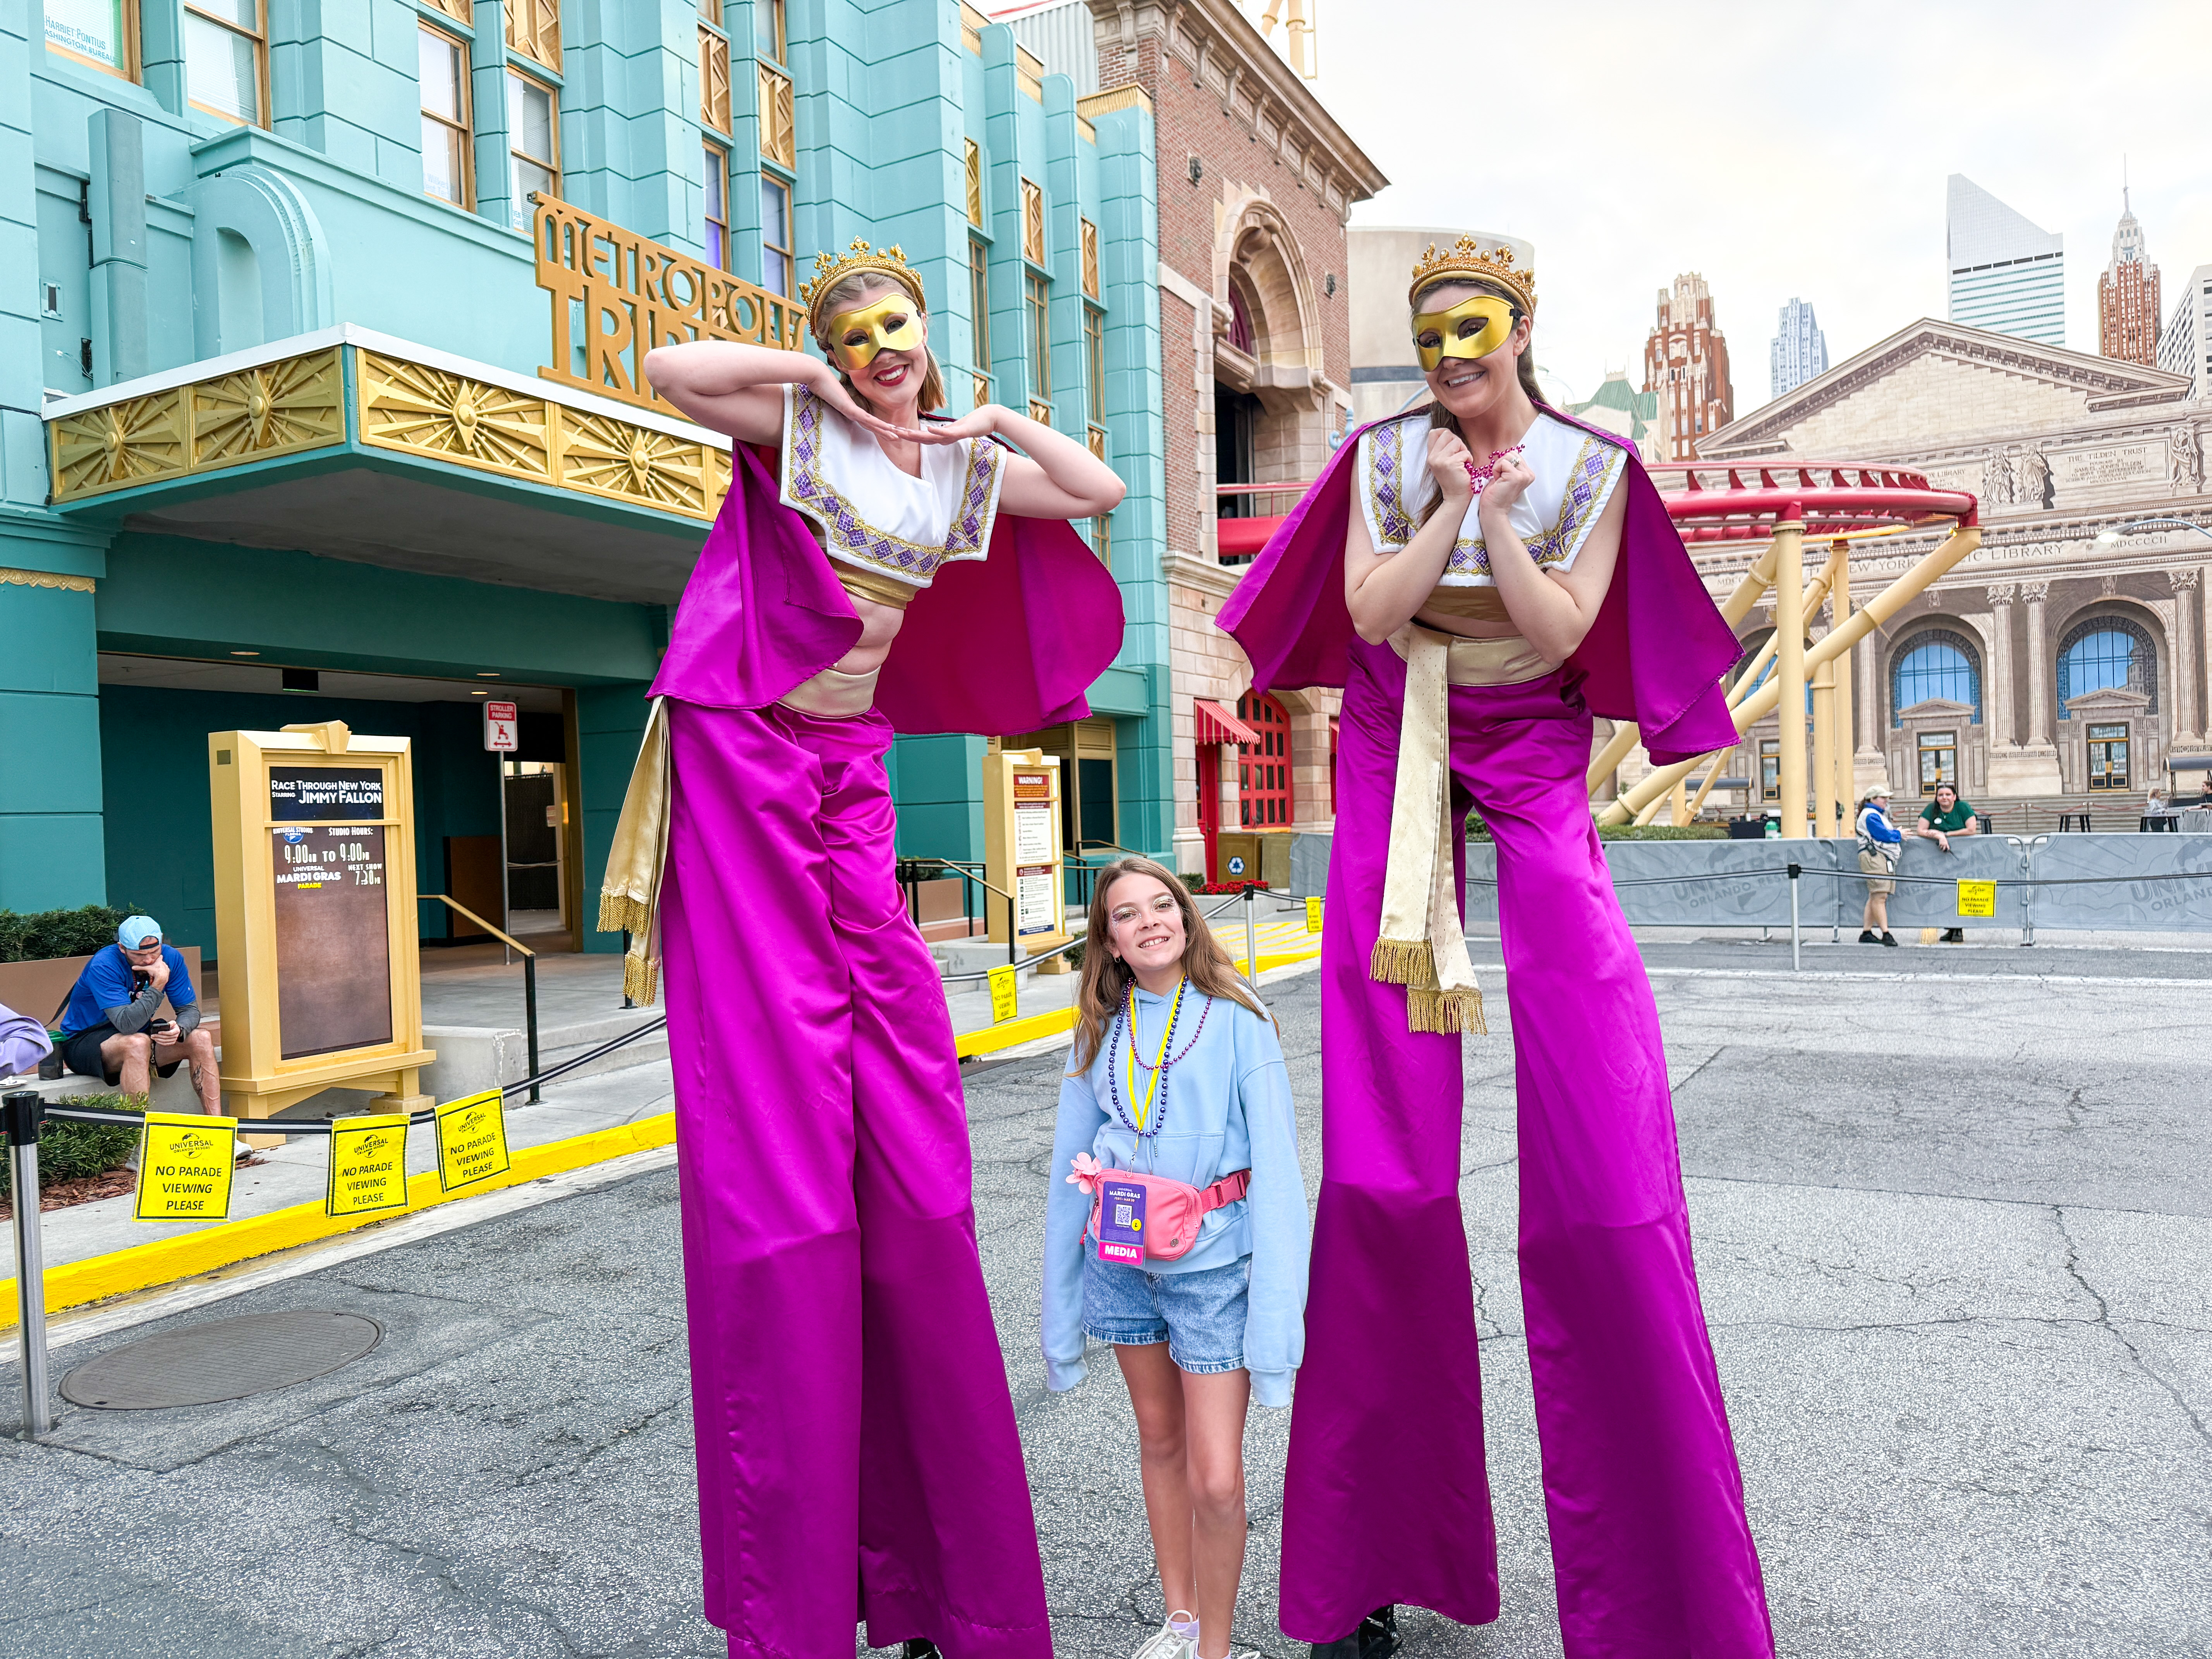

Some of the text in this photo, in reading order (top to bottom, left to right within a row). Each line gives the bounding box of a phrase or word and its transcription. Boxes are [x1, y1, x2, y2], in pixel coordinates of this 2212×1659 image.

[46, 15, 106, 50] HARRIET PONTIUS
[45, 29, 115, 62] ASHINGTON BUREAU
[533, 194, 810, 352] METROPOLIS
[2088, 450, 2116, 460] TILDEN
[2122, 447, 2147, 455] TRUST
[1937, 468, 1966, 477] LIBRARY
[1849, 562, 1871, 574] EW
[1879, 557, 1915, 571] YORK
[1992, 544, 2063, 560] LIBRARY
[271, 780, 381, 790] RACE THROUGH NEW YORK
[299, 790, 337, 804] JIMMY
[339, 790, 382, 804] FALLON
[329, 827, 373, 836] STUDIO HOURS:
[322, 851, 336, 862] TO
[277, 872, 341, 883] MARDI GRAS
[458, 1112, 486, 1132] UNIVERSAL
[170, 1140, 214, 1151] UNIVERSAL
[354, 1138, 388, 1153] UNIVERSAL
[450, 1132, 496, 1155] NO PARADE
[457, 1148, 494, 1166] VIEWING
[156, 1166, 222, 1177] NO PARADE
[342, 1162, 393, 1177] NO PARADE
[463, 1161, 493, 1178] PLEASE
[162, 1183, 213, 1194] VIEWING
[347, 1177, 386, 1191] VIEWING
[166, 1200, 204, 1210] PLEASE
[353, 1192, 384, 1205] PLEASE
[1105, 1245, 1137, 1258] MEDIA
